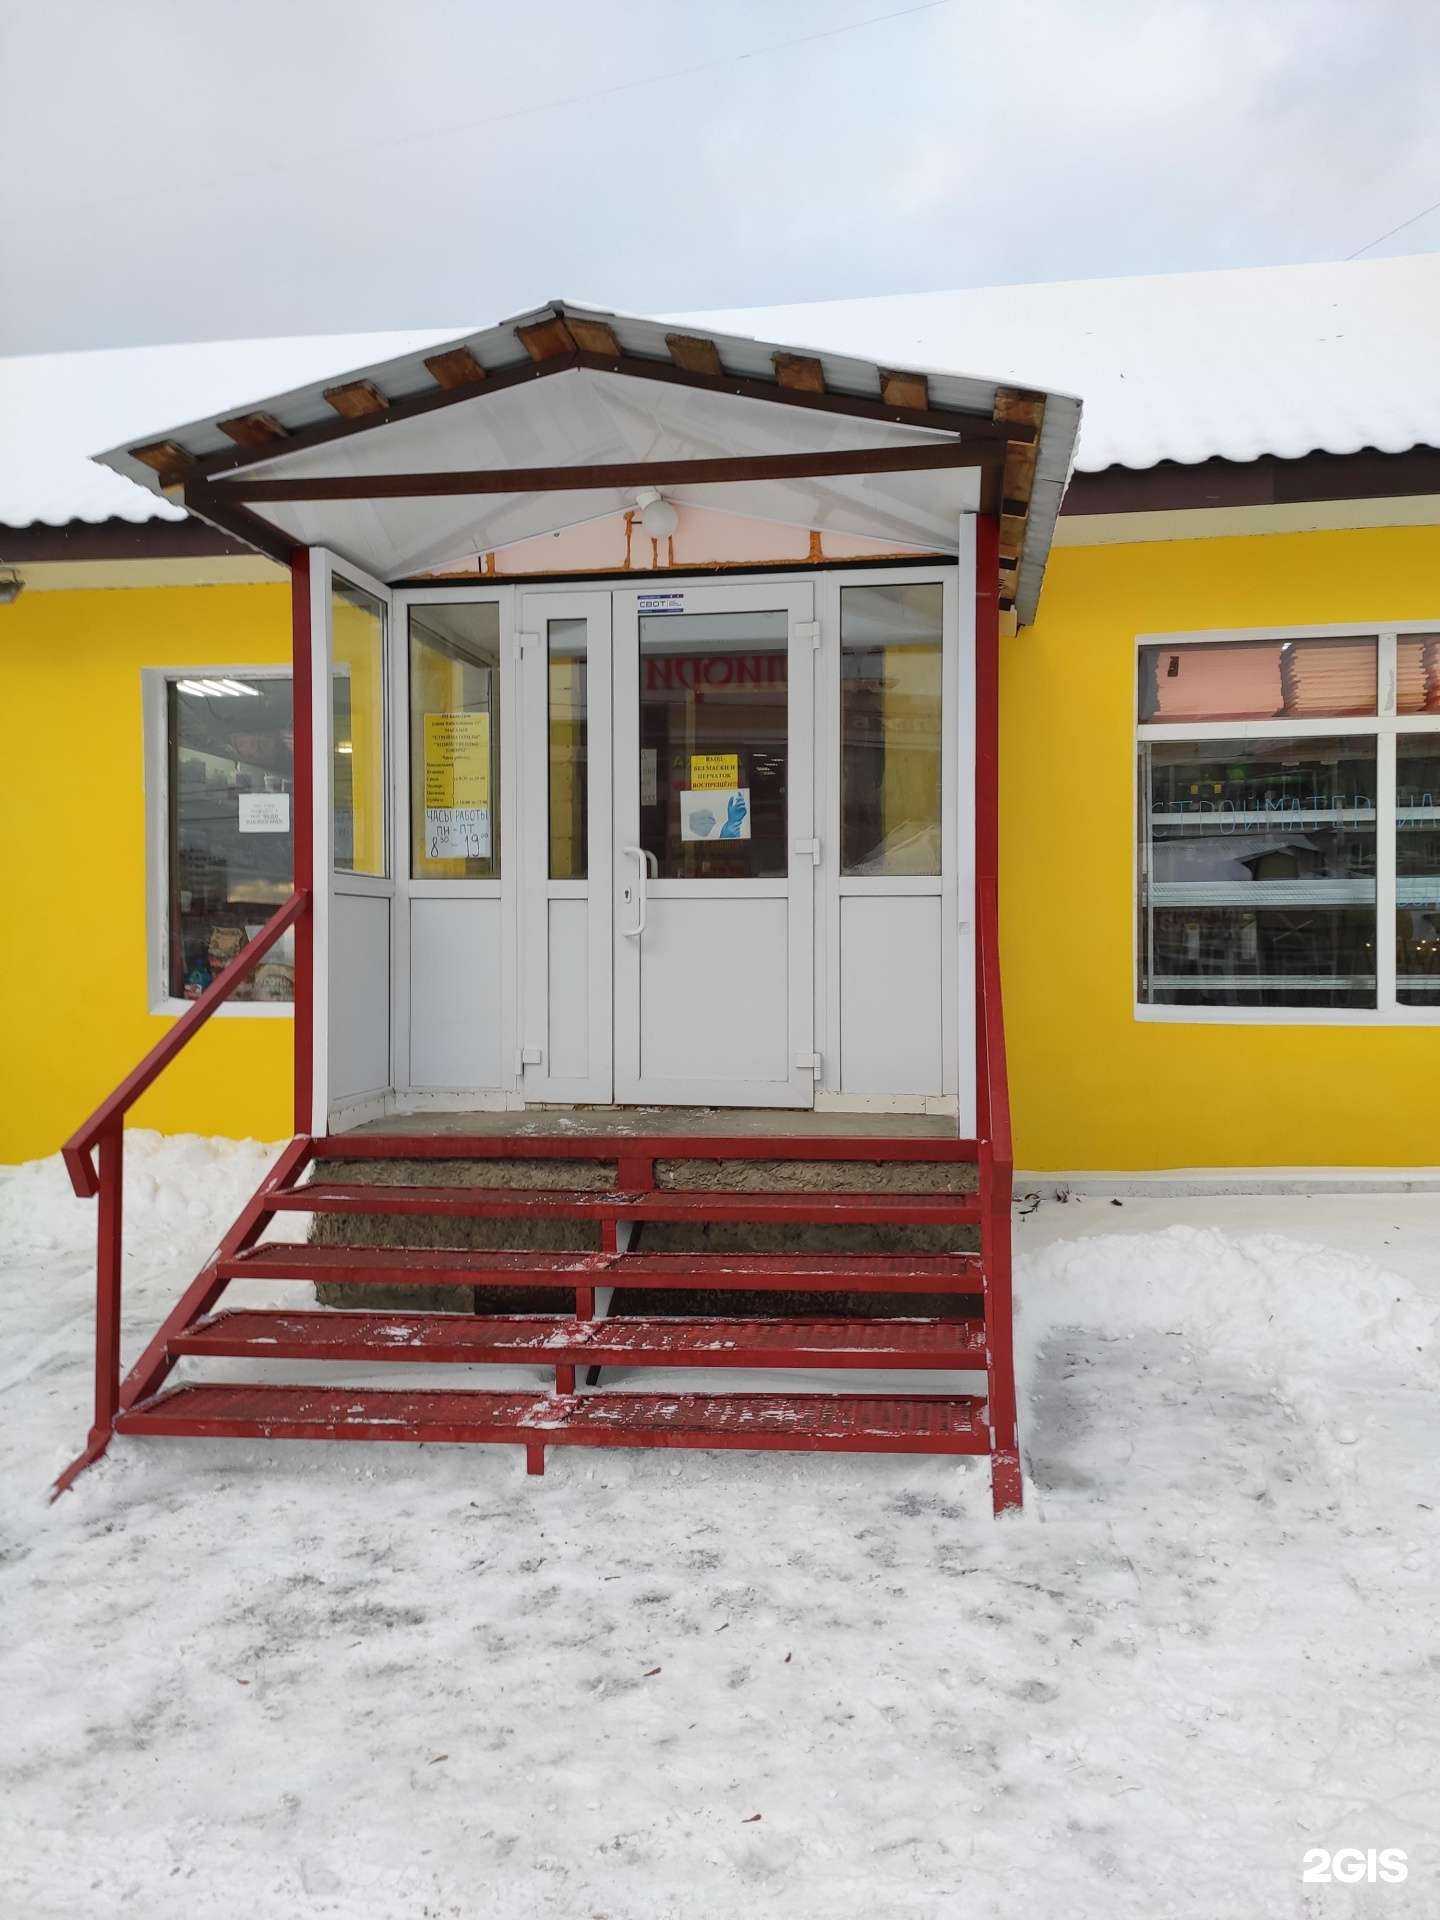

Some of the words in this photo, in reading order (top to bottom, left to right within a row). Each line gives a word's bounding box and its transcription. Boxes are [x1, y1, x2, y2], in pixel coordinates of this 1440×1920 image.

[426, 809, 453, 823] ЧАСЫ
[455, 809, 488, 821] РАБОТЫ
[436, 825, 450, 837] ПН
[459, 823, 474, 835] ПТ
